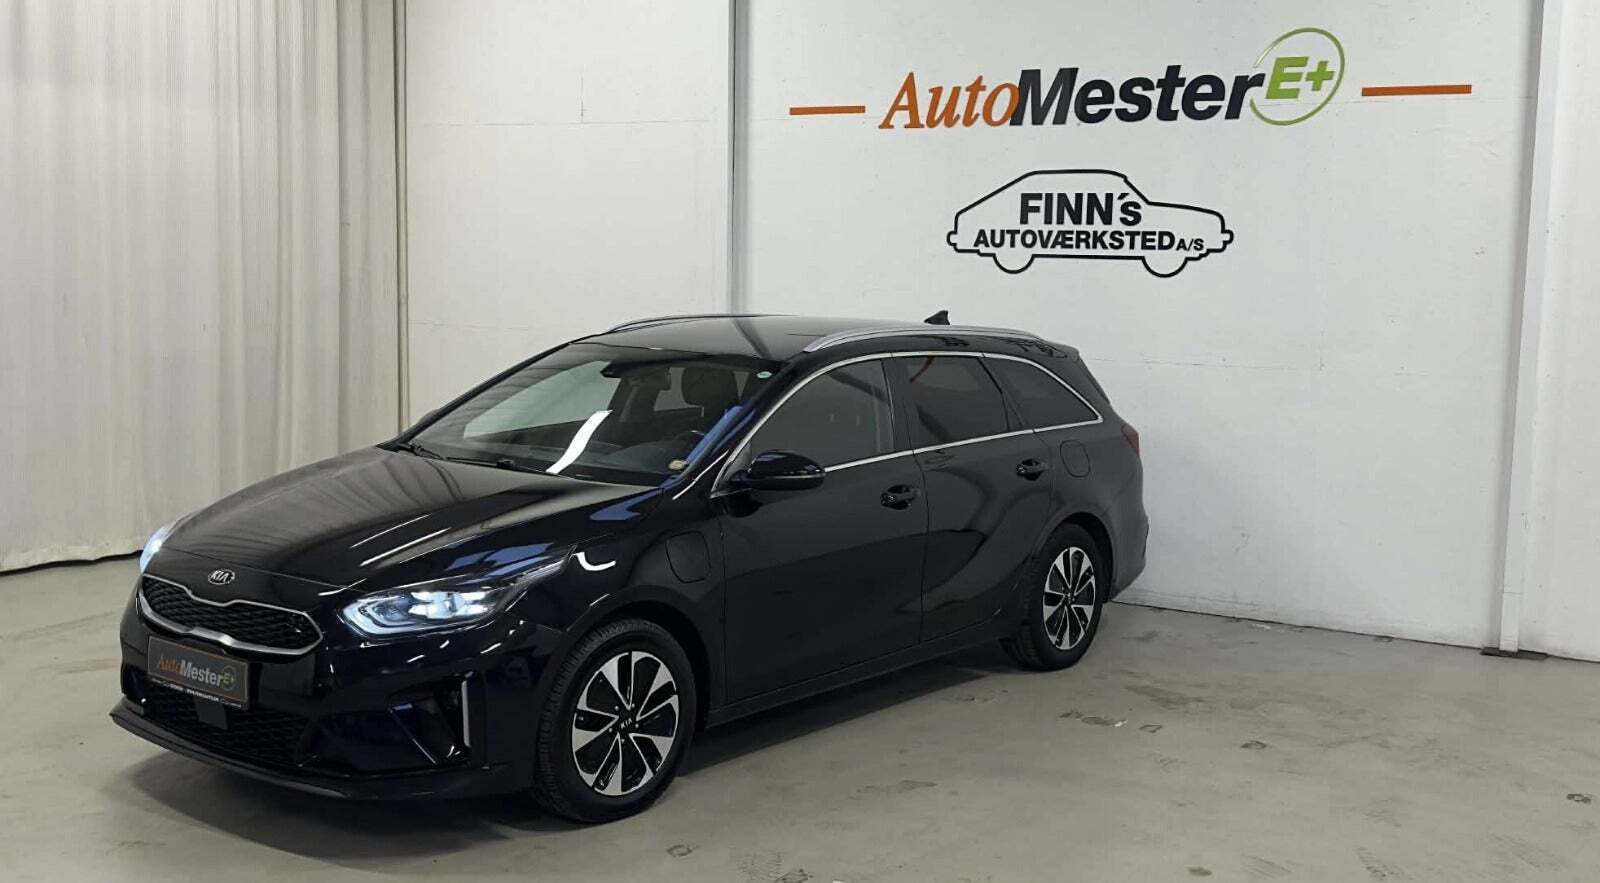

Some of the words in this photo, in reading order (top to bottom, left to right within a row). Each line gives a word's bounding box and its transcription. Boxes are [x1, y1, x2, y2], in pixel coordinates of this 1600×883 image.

[973, 229, 1174, 251] AUTOVÆRKSTED
[1176, 238, 1205, 251] A/S
[211, 570, 229, 581] KIA
